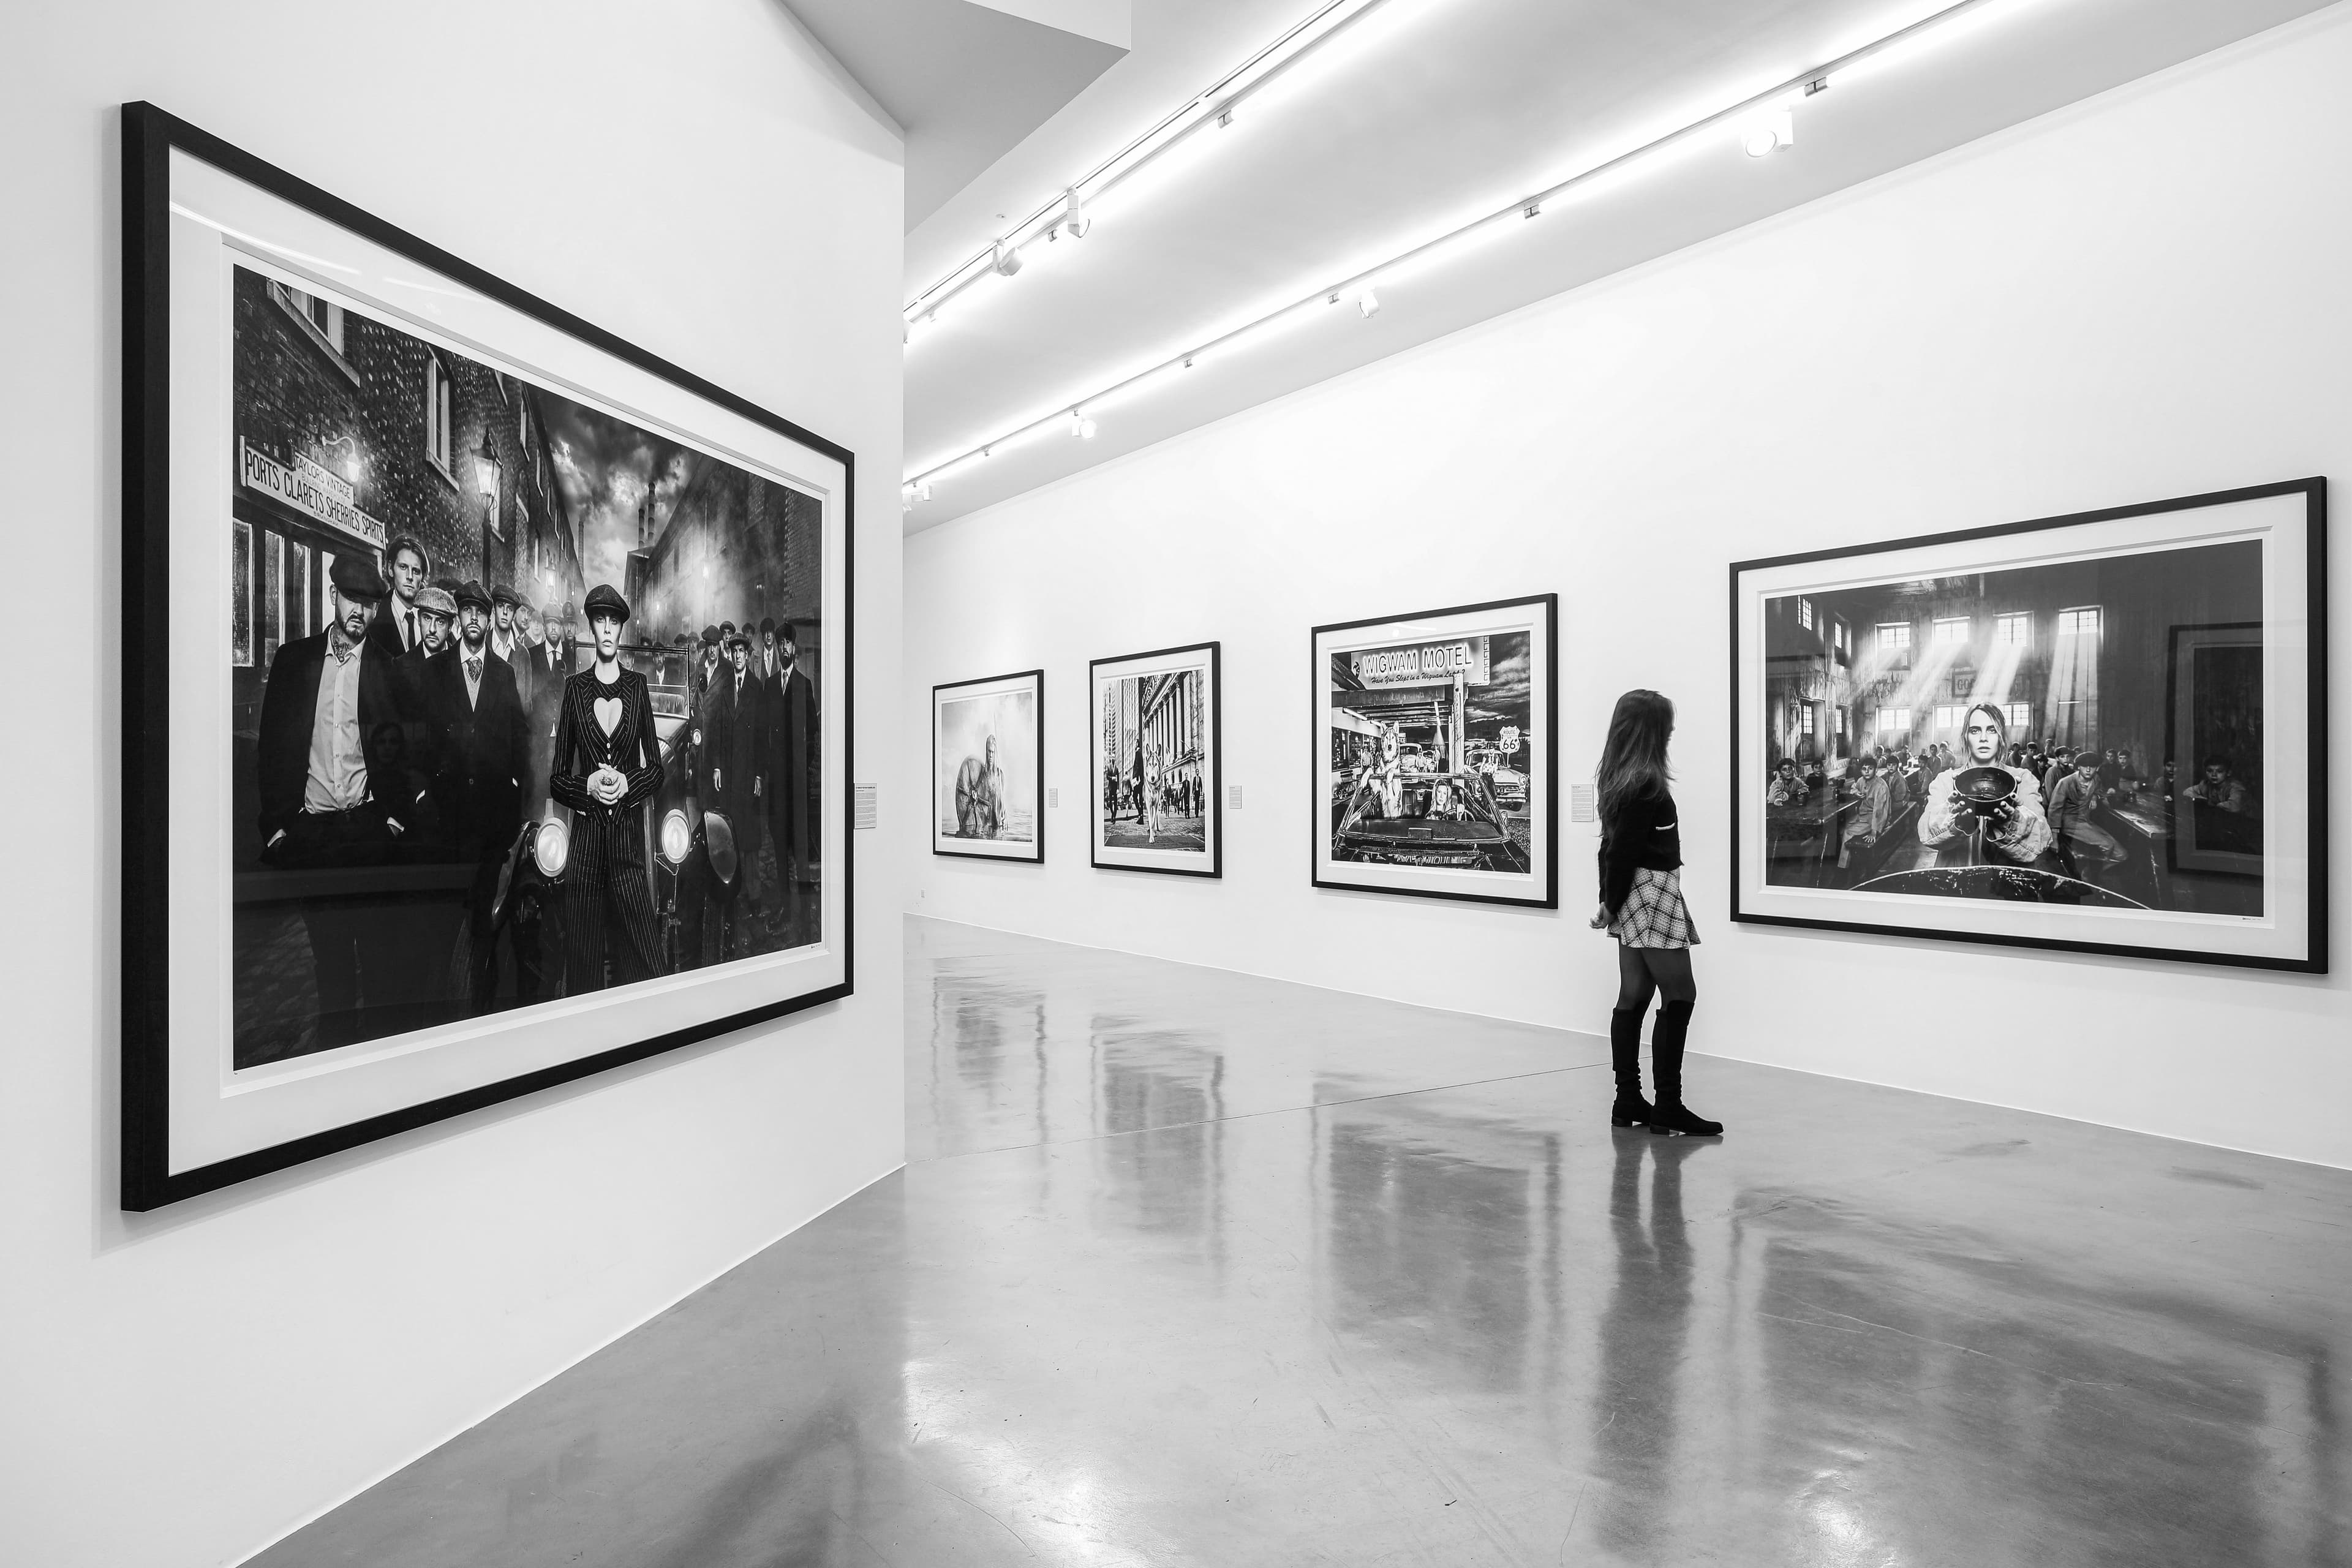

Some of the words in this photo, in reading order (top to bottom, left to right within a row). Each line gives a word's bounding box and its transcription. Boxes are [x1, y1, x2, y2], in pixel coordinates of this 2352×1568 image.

[295, 455, 324, 483] TAYLORS
[326, 475, 350, 499] VINTAGE
[246, 449, 279, 491] PORTS
[284, 472, 324, 513] CLARETS
[326, 496, 360, 531] SHERRIES
[362, 516, 383, 543] SPIRITS
[1363, 652, 1416, 674] WIGWAM
[1424, 646, 1471, 668] MOTEL
[1384, 676, 1394, 684] You
[1395, 674, 1409, 683] Slept
[1504, 739, 1516, 750] 66
